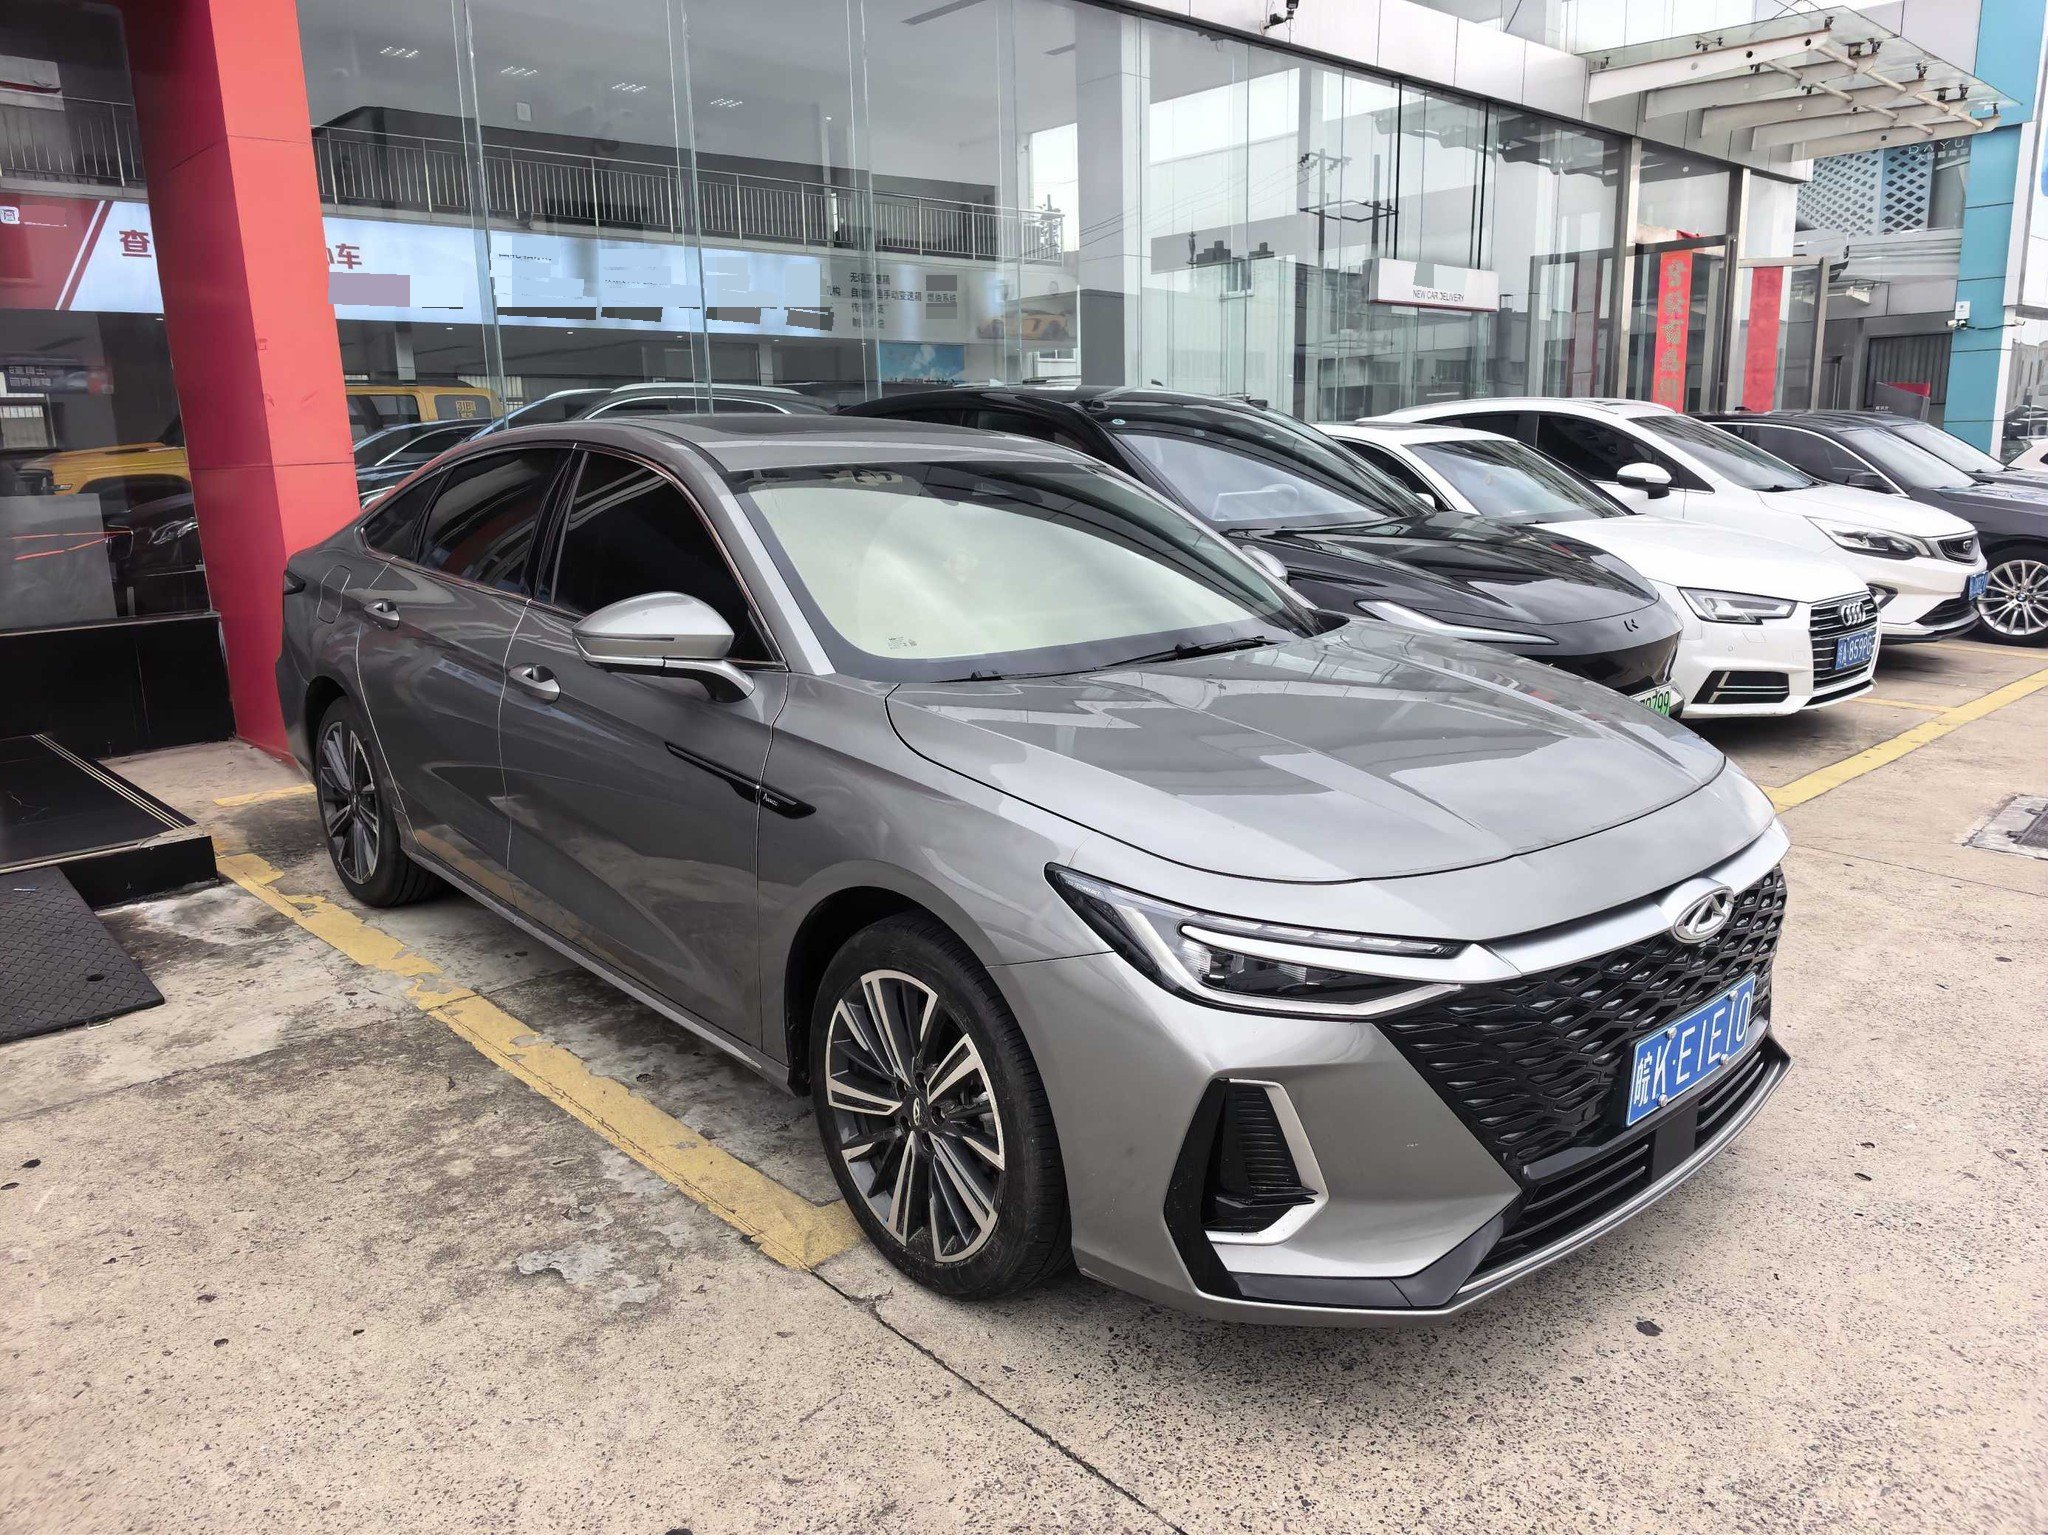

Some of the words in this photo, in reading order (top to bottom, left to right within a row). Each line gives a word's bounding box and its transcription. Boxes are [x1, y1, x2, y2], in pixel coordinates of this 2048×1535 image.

[119, 229, 152, 258] 查
[326, 243, 362, 270] 车
[1413, 289, 1426, 299] NEW
[1427, 290, 1439, 300] CAR
[1440, 291, 1464, 302] DELIVERY
[1640, 691, 1670, 715] 799
